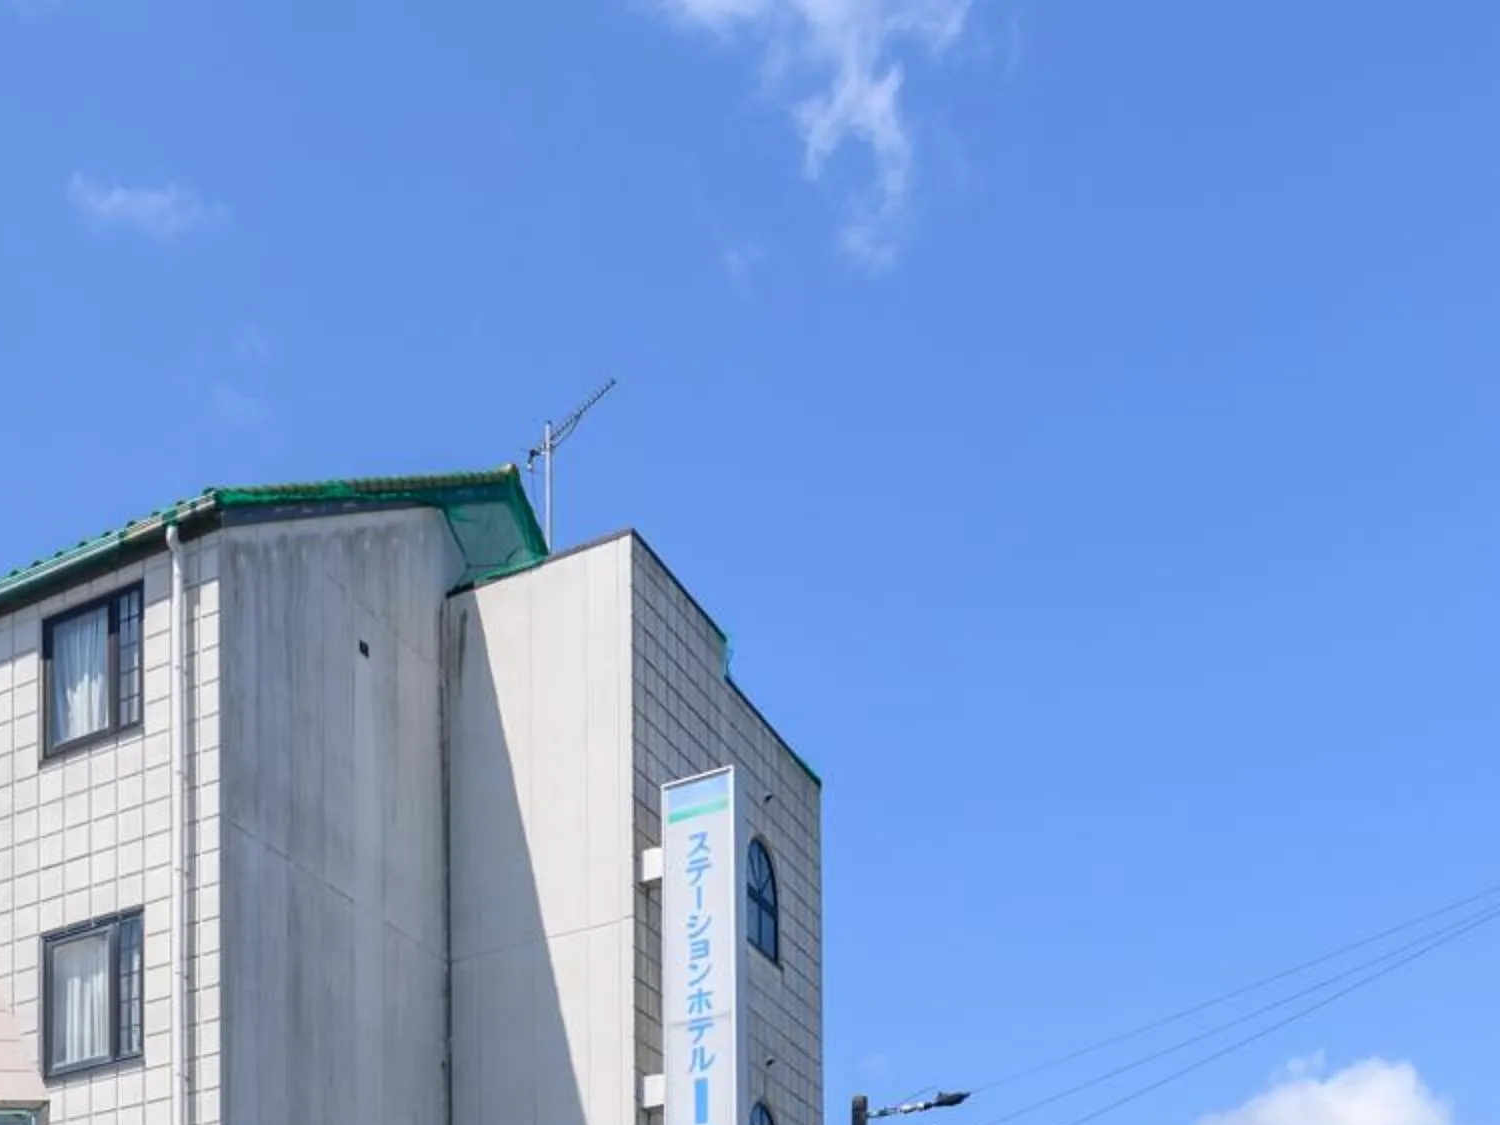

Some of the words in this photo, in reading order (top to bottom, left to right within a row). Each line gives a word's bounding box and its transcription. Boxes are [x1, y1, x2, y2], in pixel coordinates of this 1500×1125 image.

[685, 831, 717, 1074] ステーションホテル
